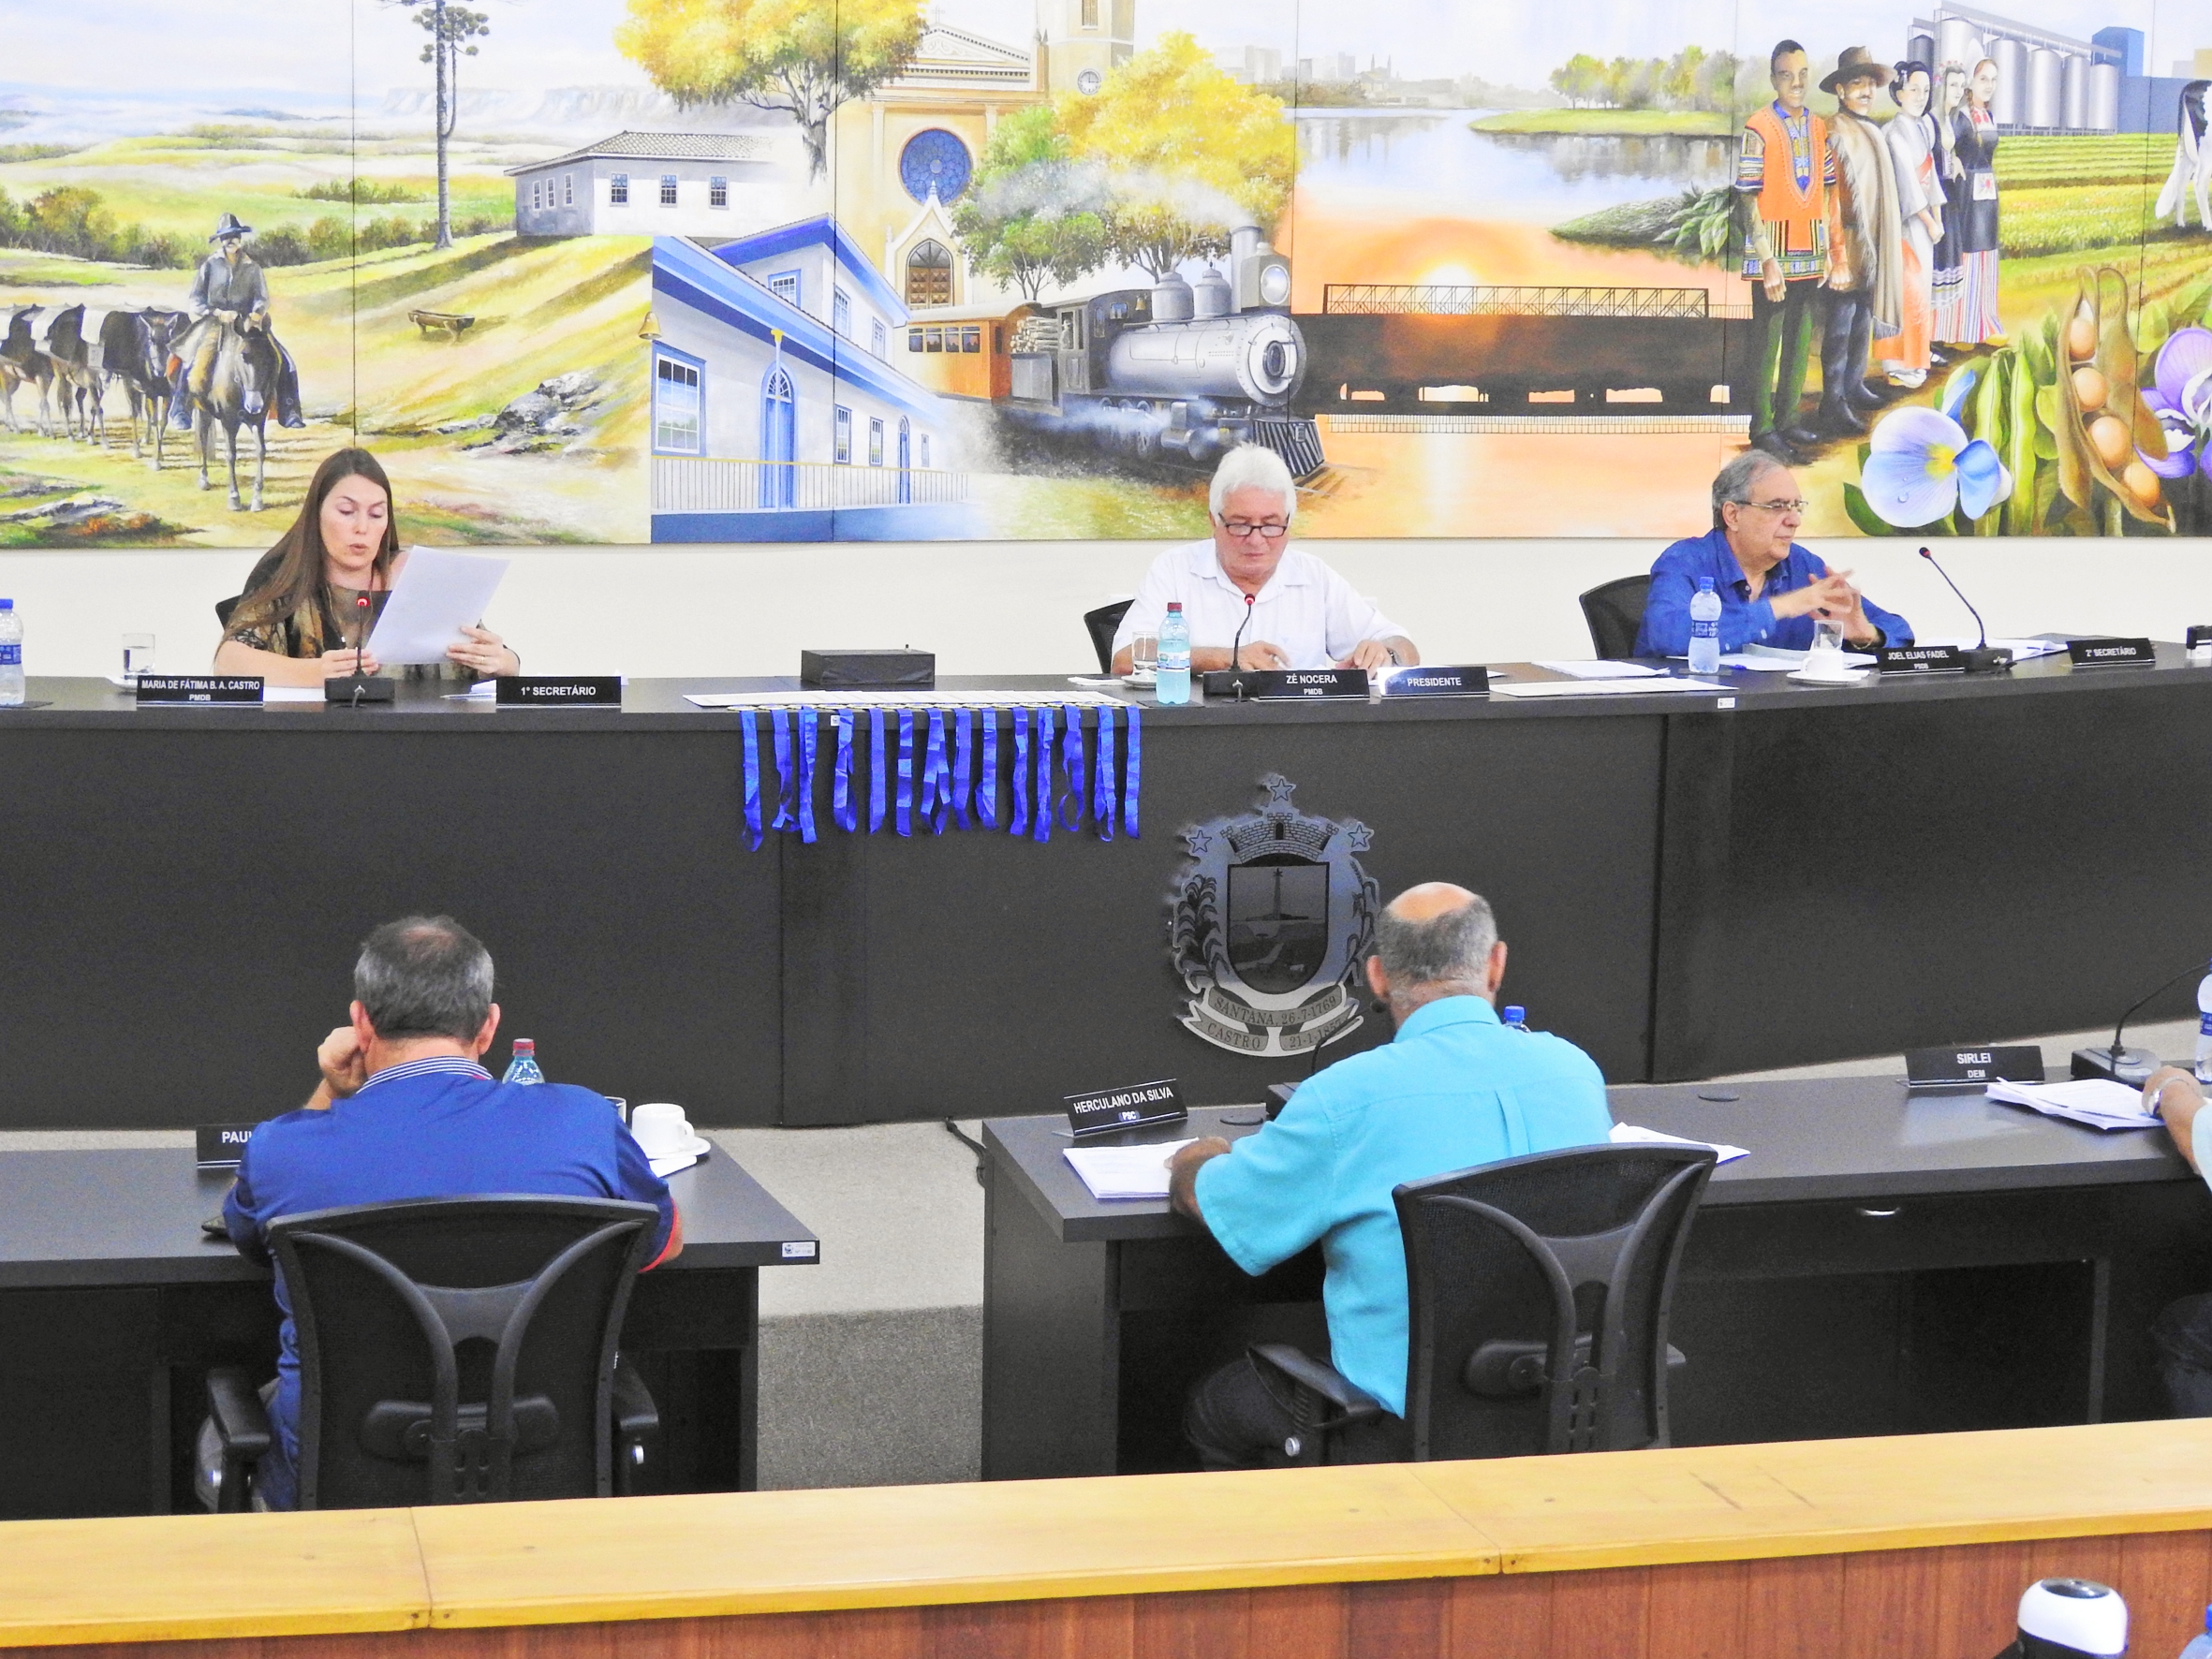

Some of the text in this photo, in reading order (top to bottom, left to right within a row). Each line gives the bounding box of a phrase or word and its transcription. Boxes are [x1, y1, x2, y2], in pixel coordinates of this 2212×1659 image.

[1887, 650, 1950, 660] JOEL ELIAS FADEL
[2093, 646, 2137, 657] SECRETÁRIO
[141, 678, 260, 690] MARIA DE FÁTIMA B. A. CASTRO
[1286, 673, 1338, 684] ZÉ NOCERA
[1407, 677, 1462, 687] PRESIDENTE
[532, 684, 597, 696] SECRETÁRIO
[1207, 1021, 1261, 1050] CASTRO
[1956, 1052, 1992, 1064] SIRLEI
[1967, 1069, 1986, 1079] DEM
[1073, 1086, 1174, 1114] HERCULANO DA SILVA
[1121, 1110, 1137, 1121] PSC
